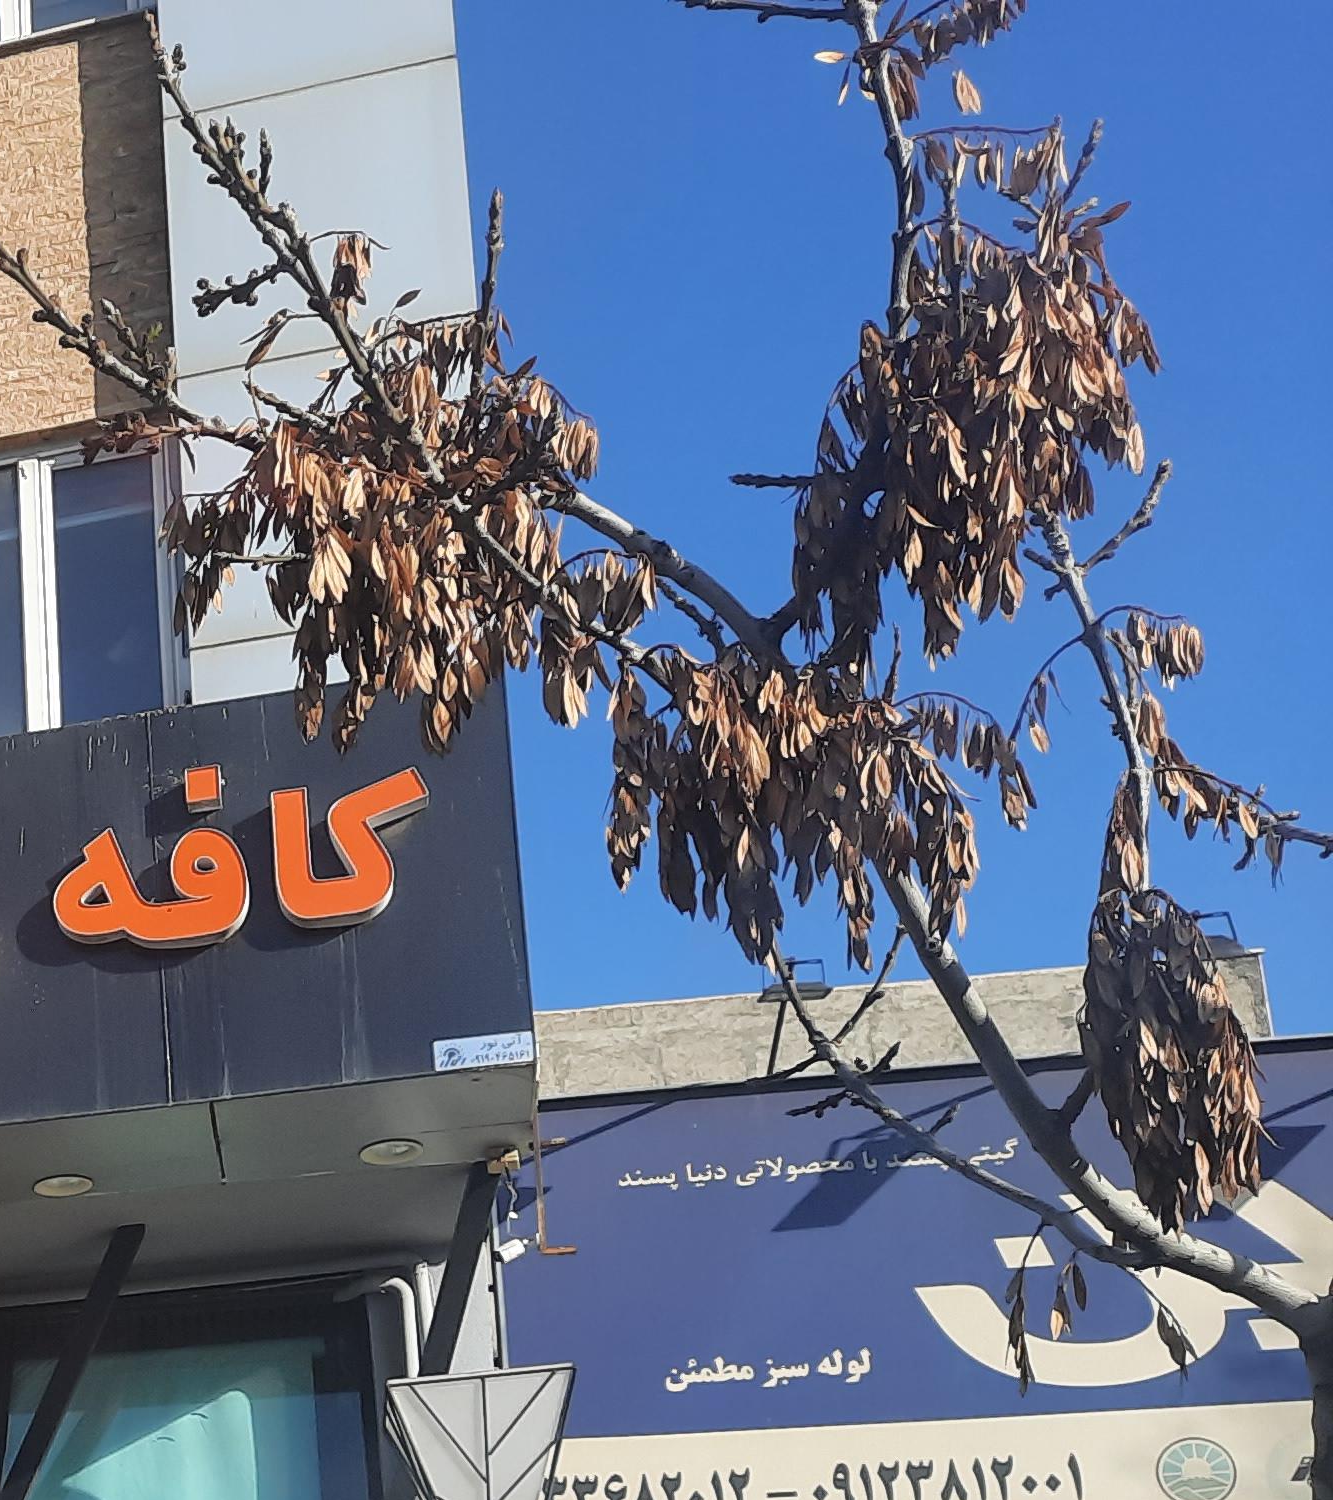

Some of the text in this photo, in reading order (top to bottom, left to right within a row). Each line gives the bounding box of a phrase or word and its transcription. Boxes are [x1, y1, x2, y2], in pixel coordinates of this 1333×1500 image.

[53, 765, 427, 942] کافه
[685, 1162, 728, 1188] دنیا
[735, 1155, 854, 1187] محصولاتی
[861, 1150, 878, 1175] با
[618, 1168, 679, 1191] پسند
[665, 1347, 872, 1393] لوله سبز مطمئن
